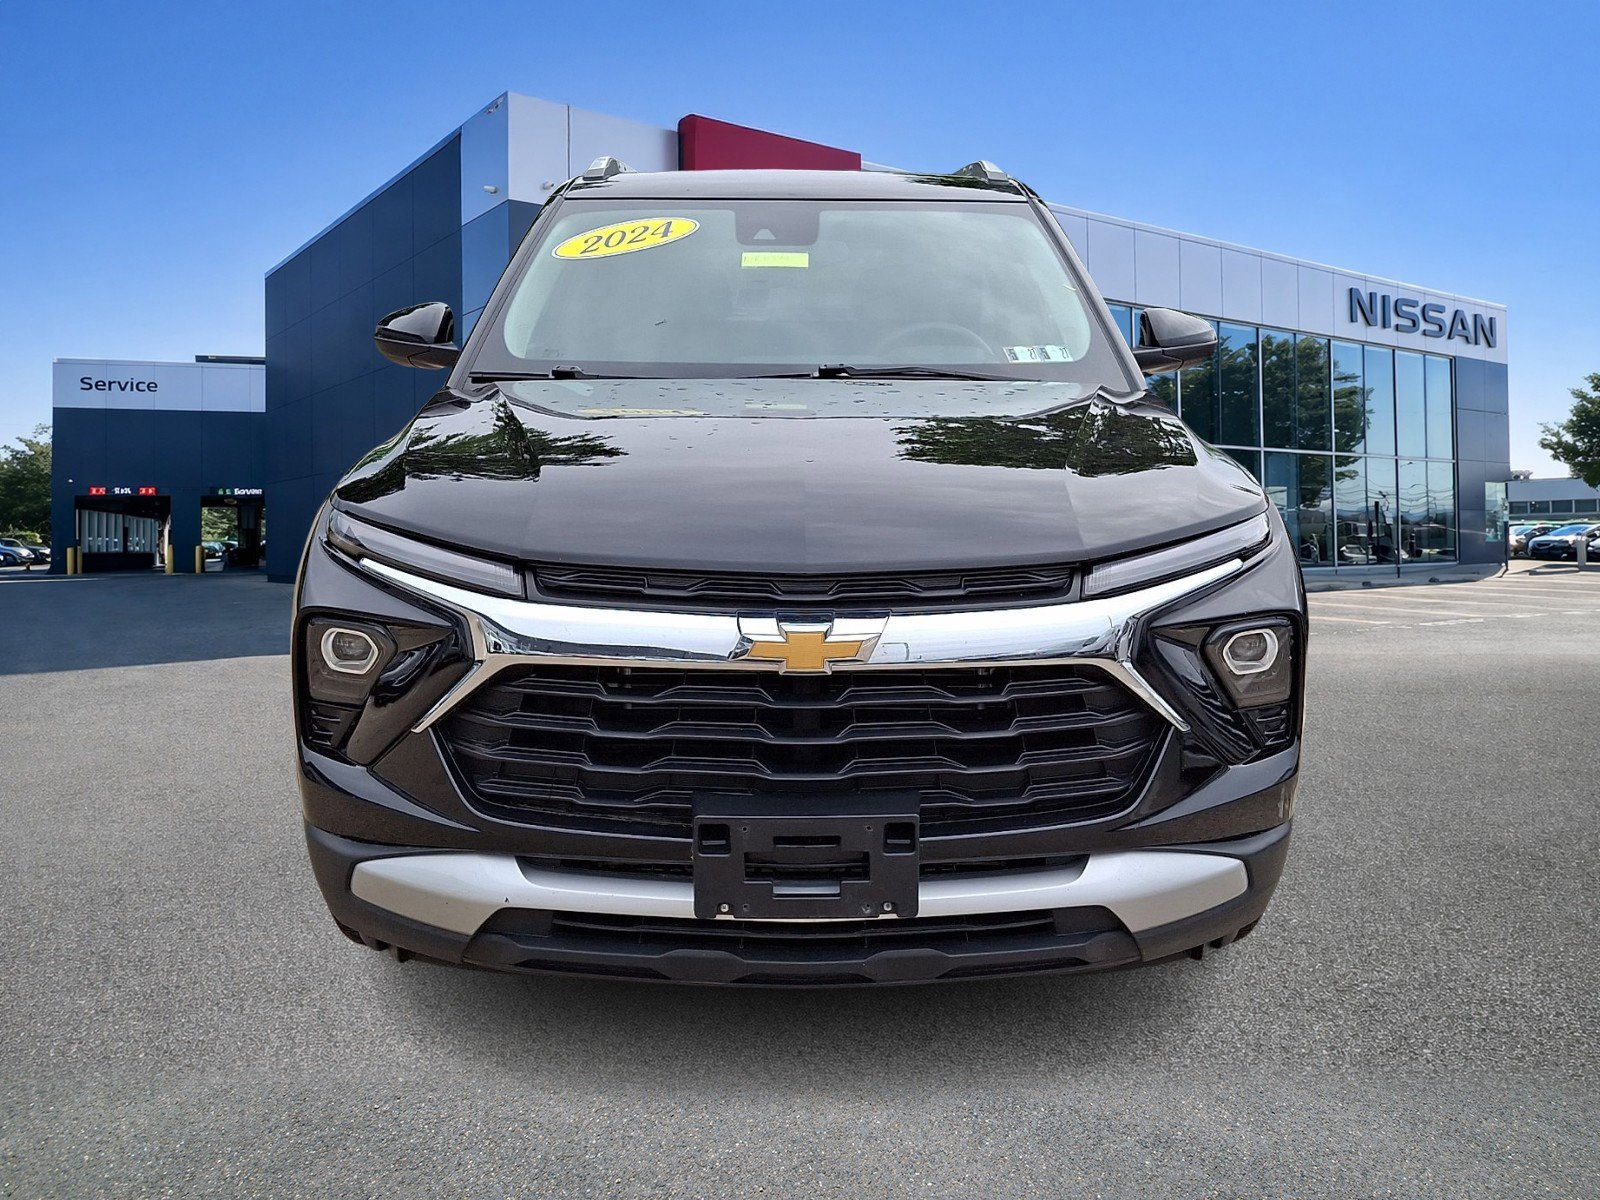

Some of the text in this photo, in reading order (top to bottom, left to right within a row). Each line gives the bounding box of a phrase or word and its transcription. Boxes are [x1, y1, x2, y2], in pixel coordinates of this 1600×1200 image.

[579, 220, 673, 255] 2024
[1348, 287, 1498, 348] NISSAN
[79, 376, 159, 393] Service
